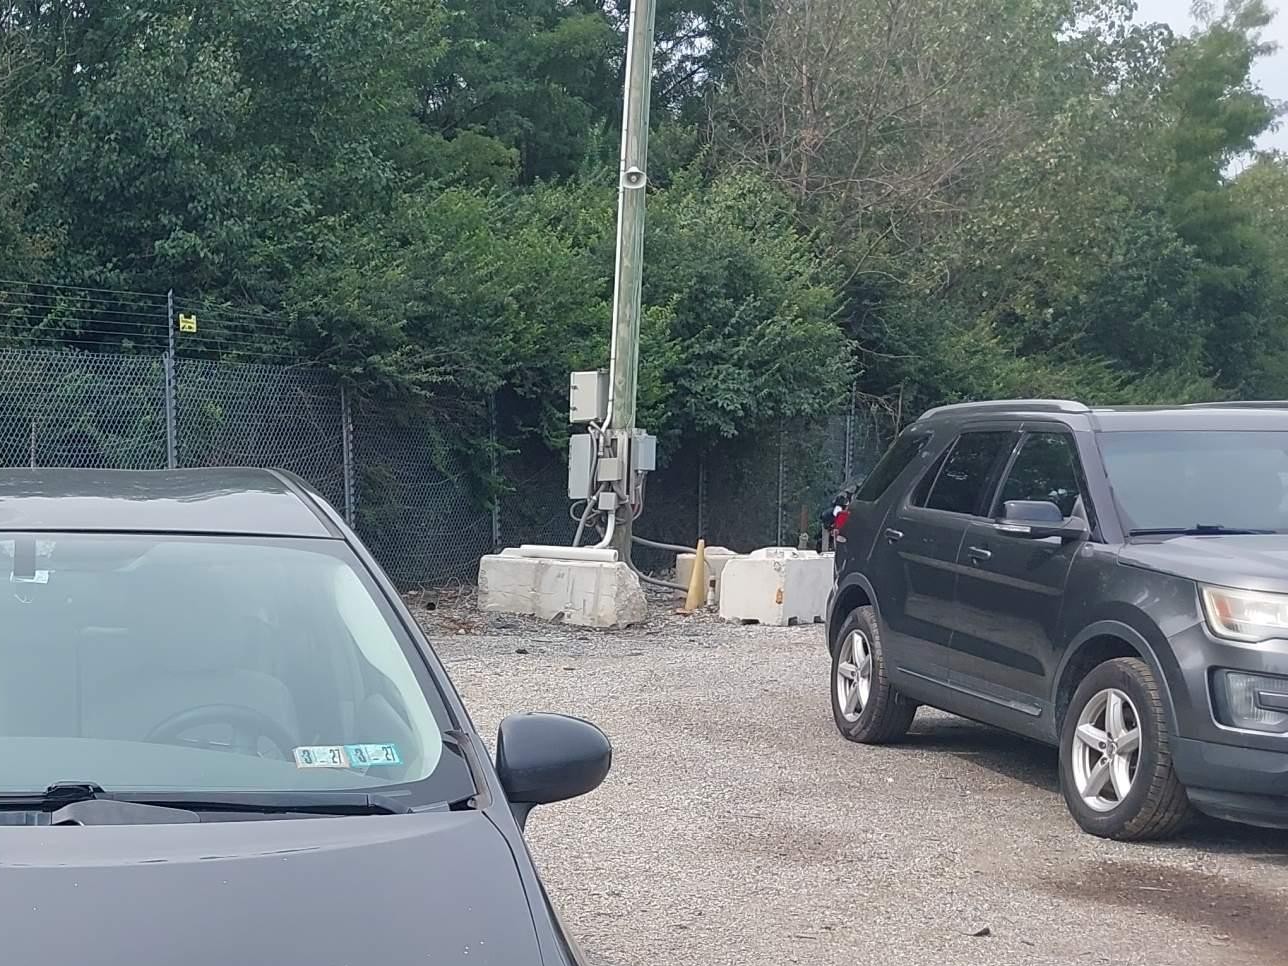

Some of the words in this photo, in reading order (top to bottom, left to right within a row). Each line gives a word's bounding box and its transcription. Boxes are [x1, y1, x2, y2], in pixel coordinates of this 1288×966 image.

[302, 749, 312, 764] 3
[330, 749, 342, 763] 27
[355, 748, 366, 763] 3
[382, 746, 395, 761] 27
